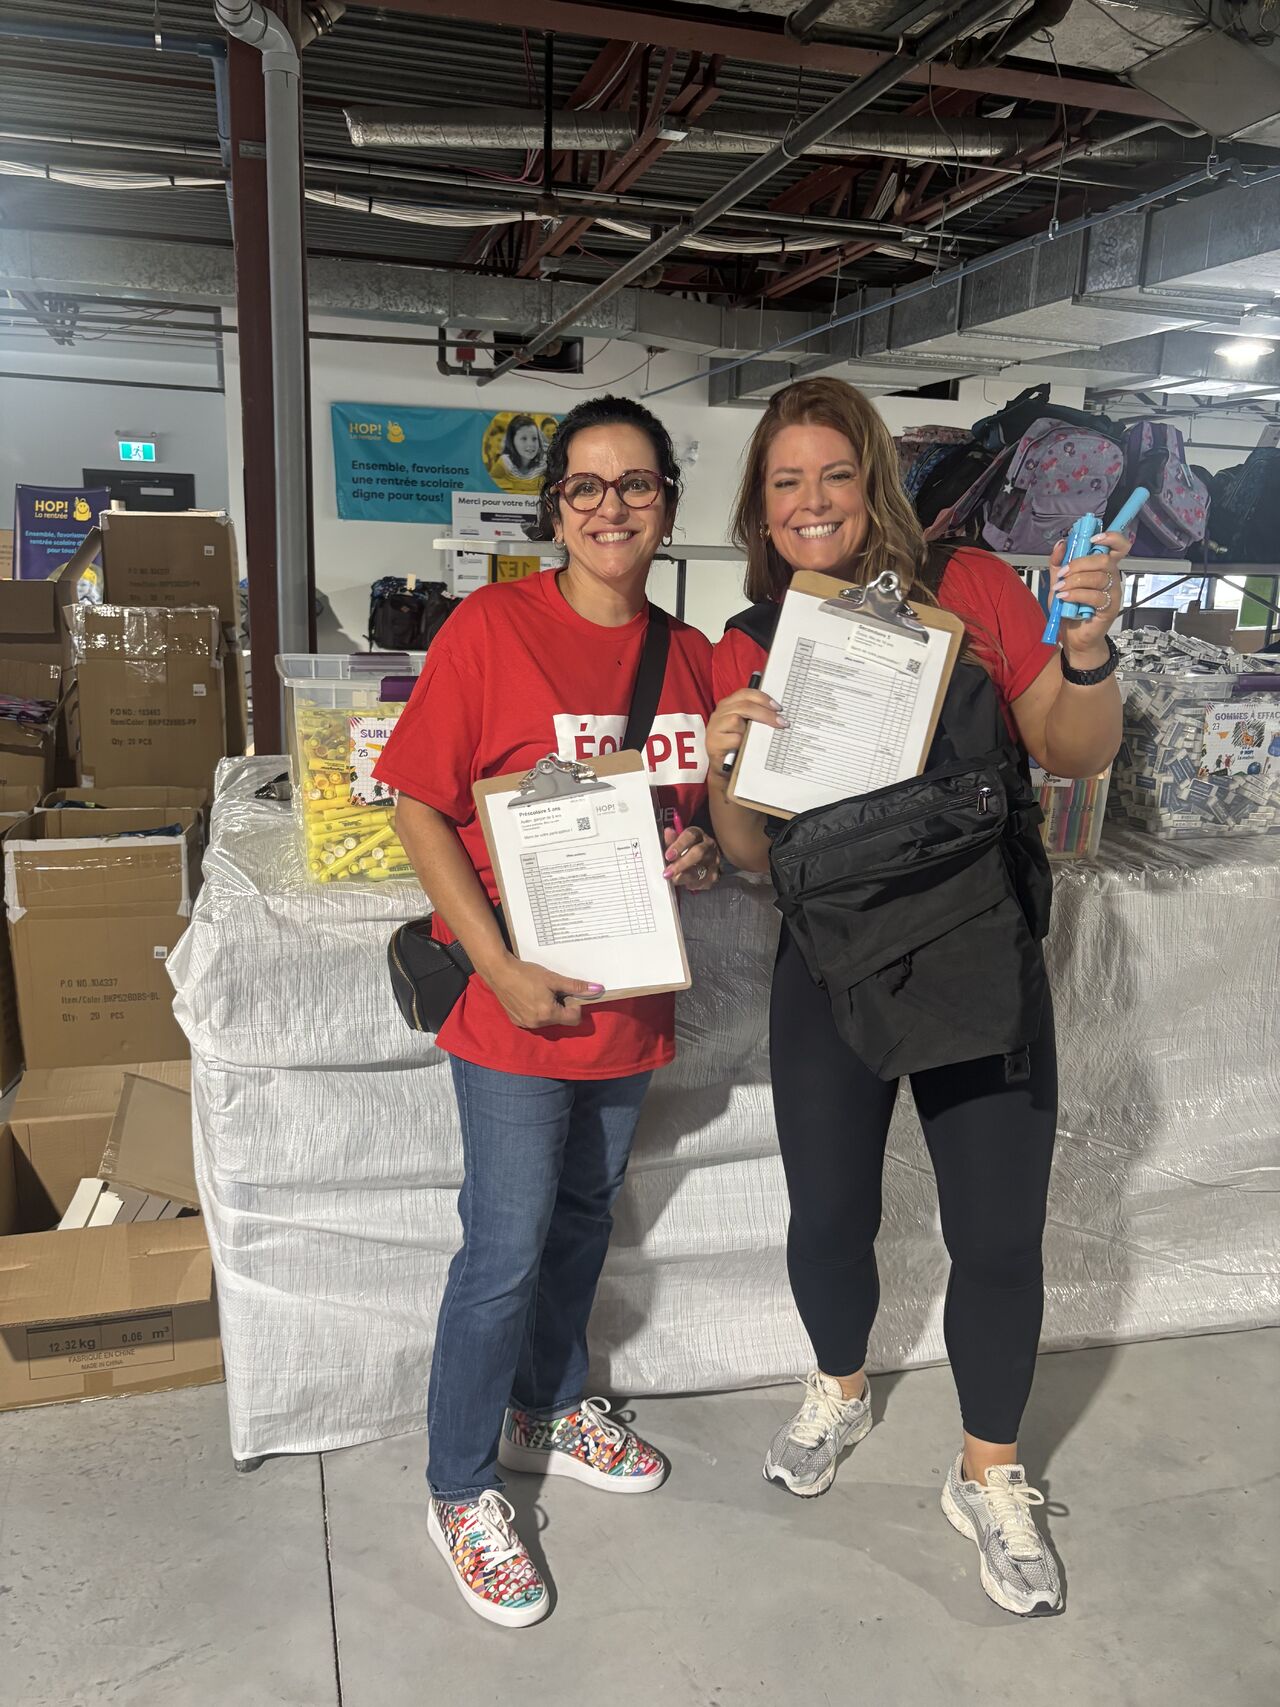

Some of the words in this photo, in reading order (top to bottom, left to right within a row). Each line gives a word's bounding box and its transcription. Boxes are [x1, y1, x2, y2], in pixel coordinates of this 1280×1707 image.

[349, 422, 382, 435] HOP!
[352, 460, 409, 474] Ensemble,
[412, 463, 470, 476] favorisons
[352, 476, 374, 485] une
[376, 475, 418, 487] rentrée
[420, 478, 464, 489] scolaire
[352, 489, 385, 501] digne
[388, 490, 413, 502] pour
[416, 491, 444, 503] tous!
[34, 500, 68, 513] HOP!
[458, 497, 481, 505] Merci
[482, 499, 500, 507] pour
[502, 499, 523, 507] votre
[1214, 712, 1249, 721] GOMMES
[360, 728, 393, 739] SURL
[357, 748, 369, 758] 25
[595, 804, 616, 813] HOP!
[109, 1011, 125, 1020] PCS
[49, 1340, 77, 1353] 12.32
[79, 1338, 96, 1351] kg
[104, 1350, 114, 1359] EN
[114, 1349, 136, 1358] CHINE
[81, 1362, 97, 1370] MADE
